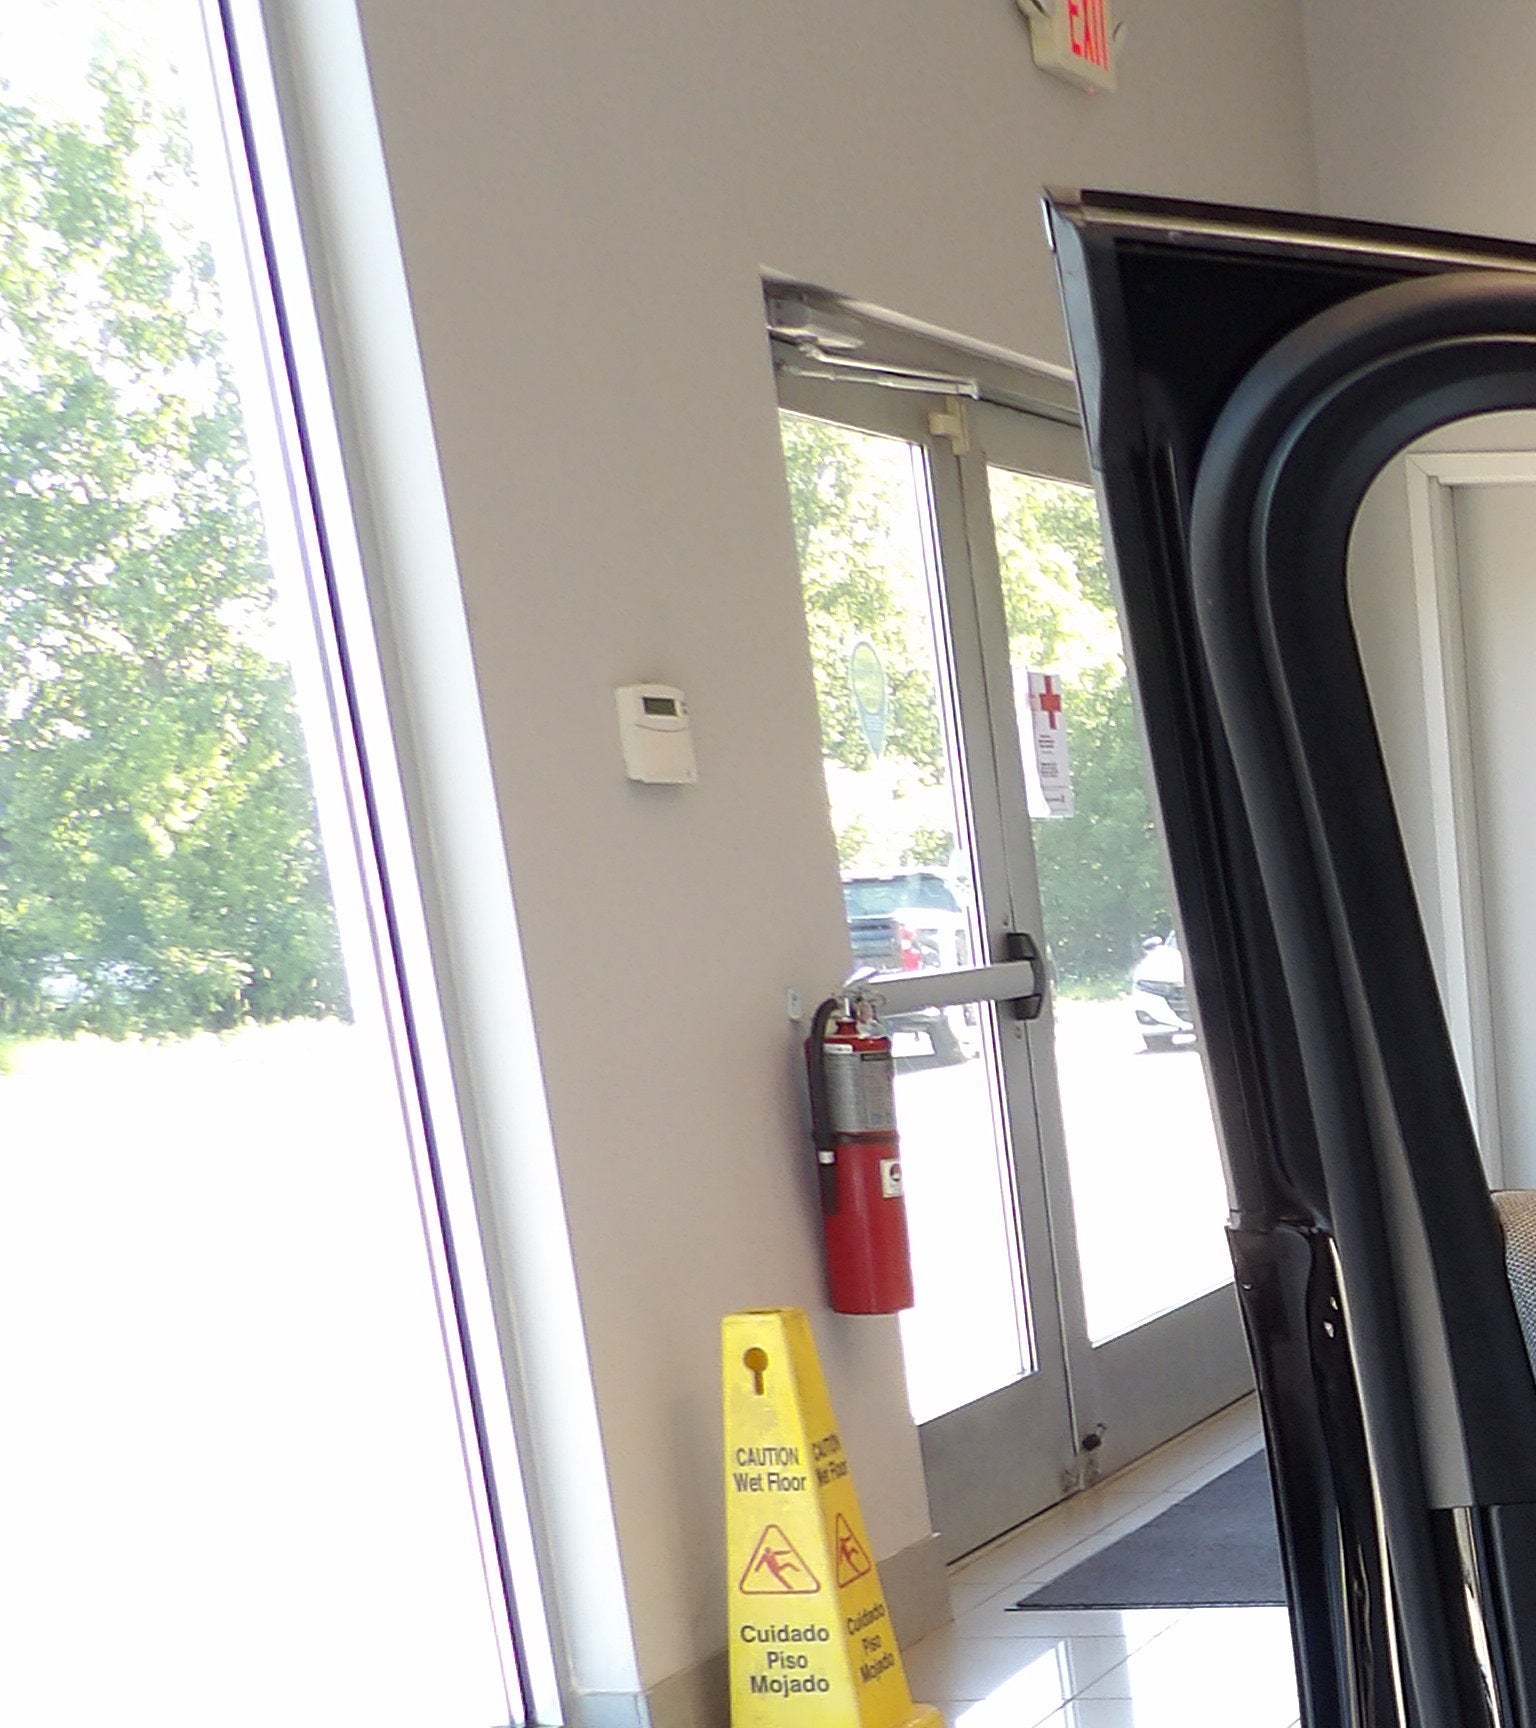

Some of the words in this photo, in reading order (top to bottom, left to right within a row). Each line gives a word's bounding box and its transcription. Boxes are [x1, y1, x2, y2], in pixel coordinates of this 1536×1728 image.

[736, 1447, 800, 1467] CAUTION
[733, 1472, 764, 1493] Wet
[767, 1471, 807, 1492] Floor
[740, 1624, 830, 1644] Cuidado
[766, 1650, 809, 1670] Piso
[750, 1674, 830, 1698] Mojado
